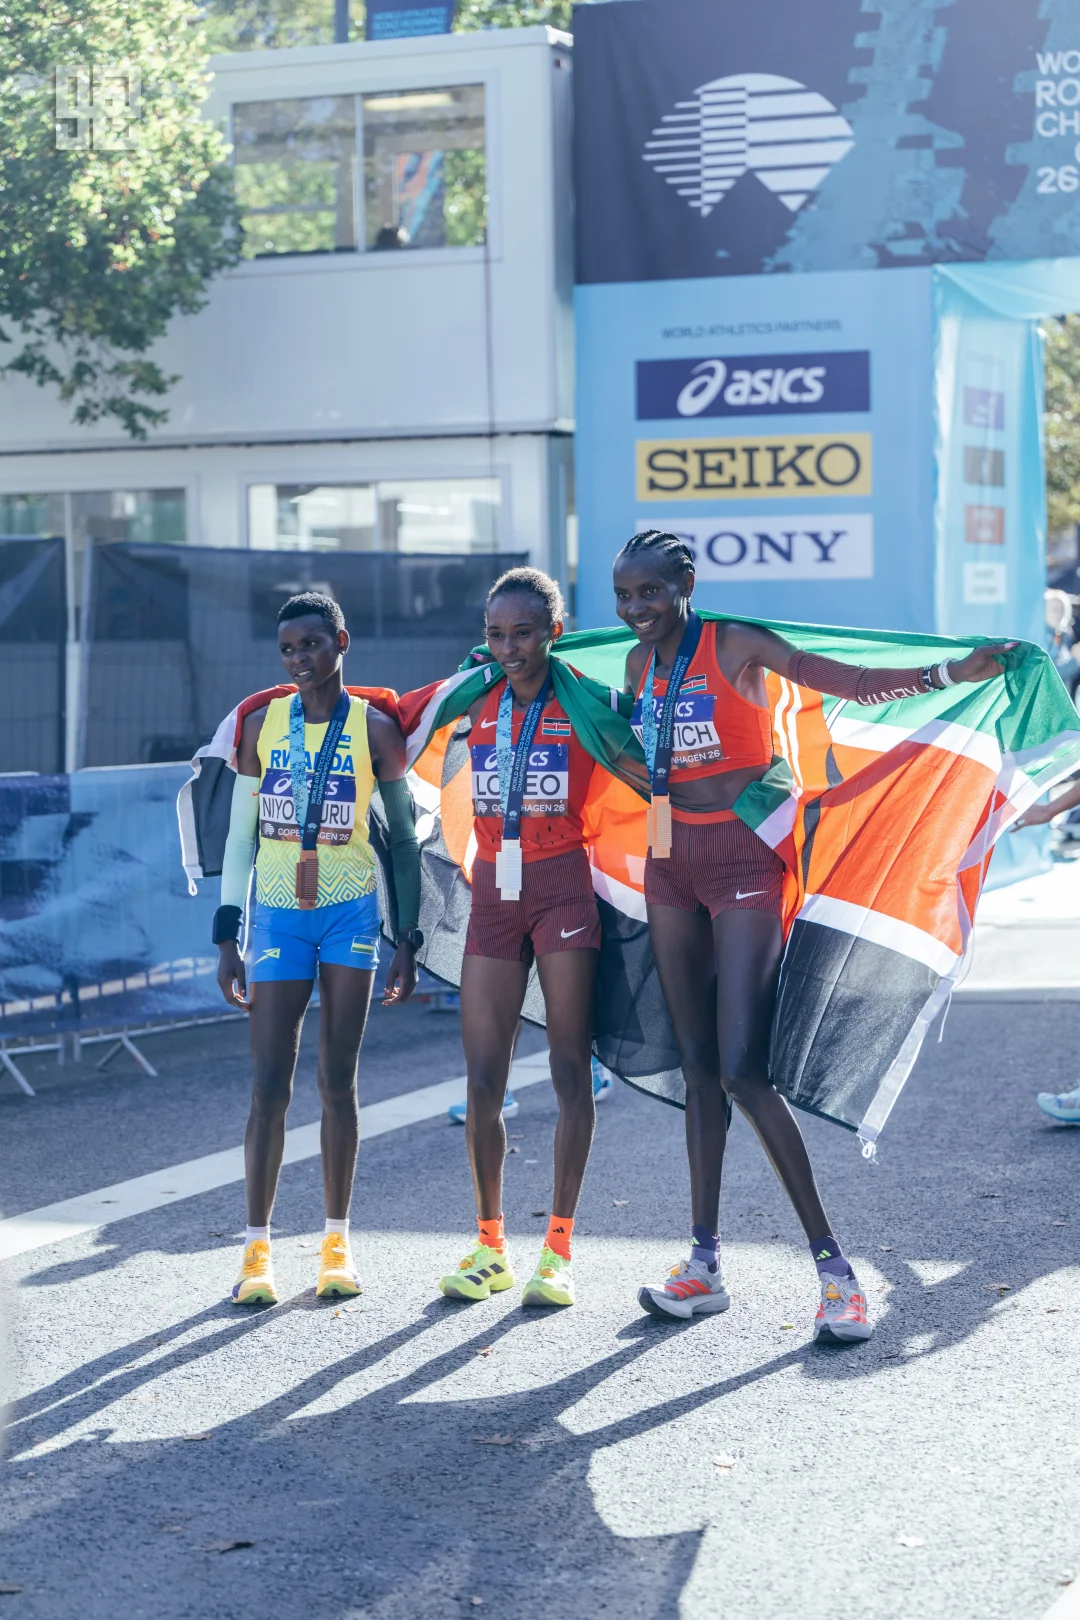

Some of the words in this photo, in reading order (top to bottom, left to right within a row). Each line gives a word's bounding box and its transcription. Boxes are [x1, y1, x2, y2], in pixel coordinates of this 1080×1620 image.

[1035, 50, 1080, 75] WO
[1035, 78, 1080, 108] RO
[1036, 110, 1080, 137] CH
[1036, 165, 1080, 193] 26
[661, 325, 704, 339] WORLD
[708, 321, 773, 336] ATHLETICS
[774, 318, 843, 333] PARTNERS
[647, 441, 861, 492] SEIKO
[671, 752, 706, 764] NHAGEN
[708, 750, 720, 759] 26
[476, 774, 560, 796] LOEO
[492, 804, 552, 812] COHAGEN
[554, 804, 565, 812] 26
[278, 828, 338, 840] COPEGEN
